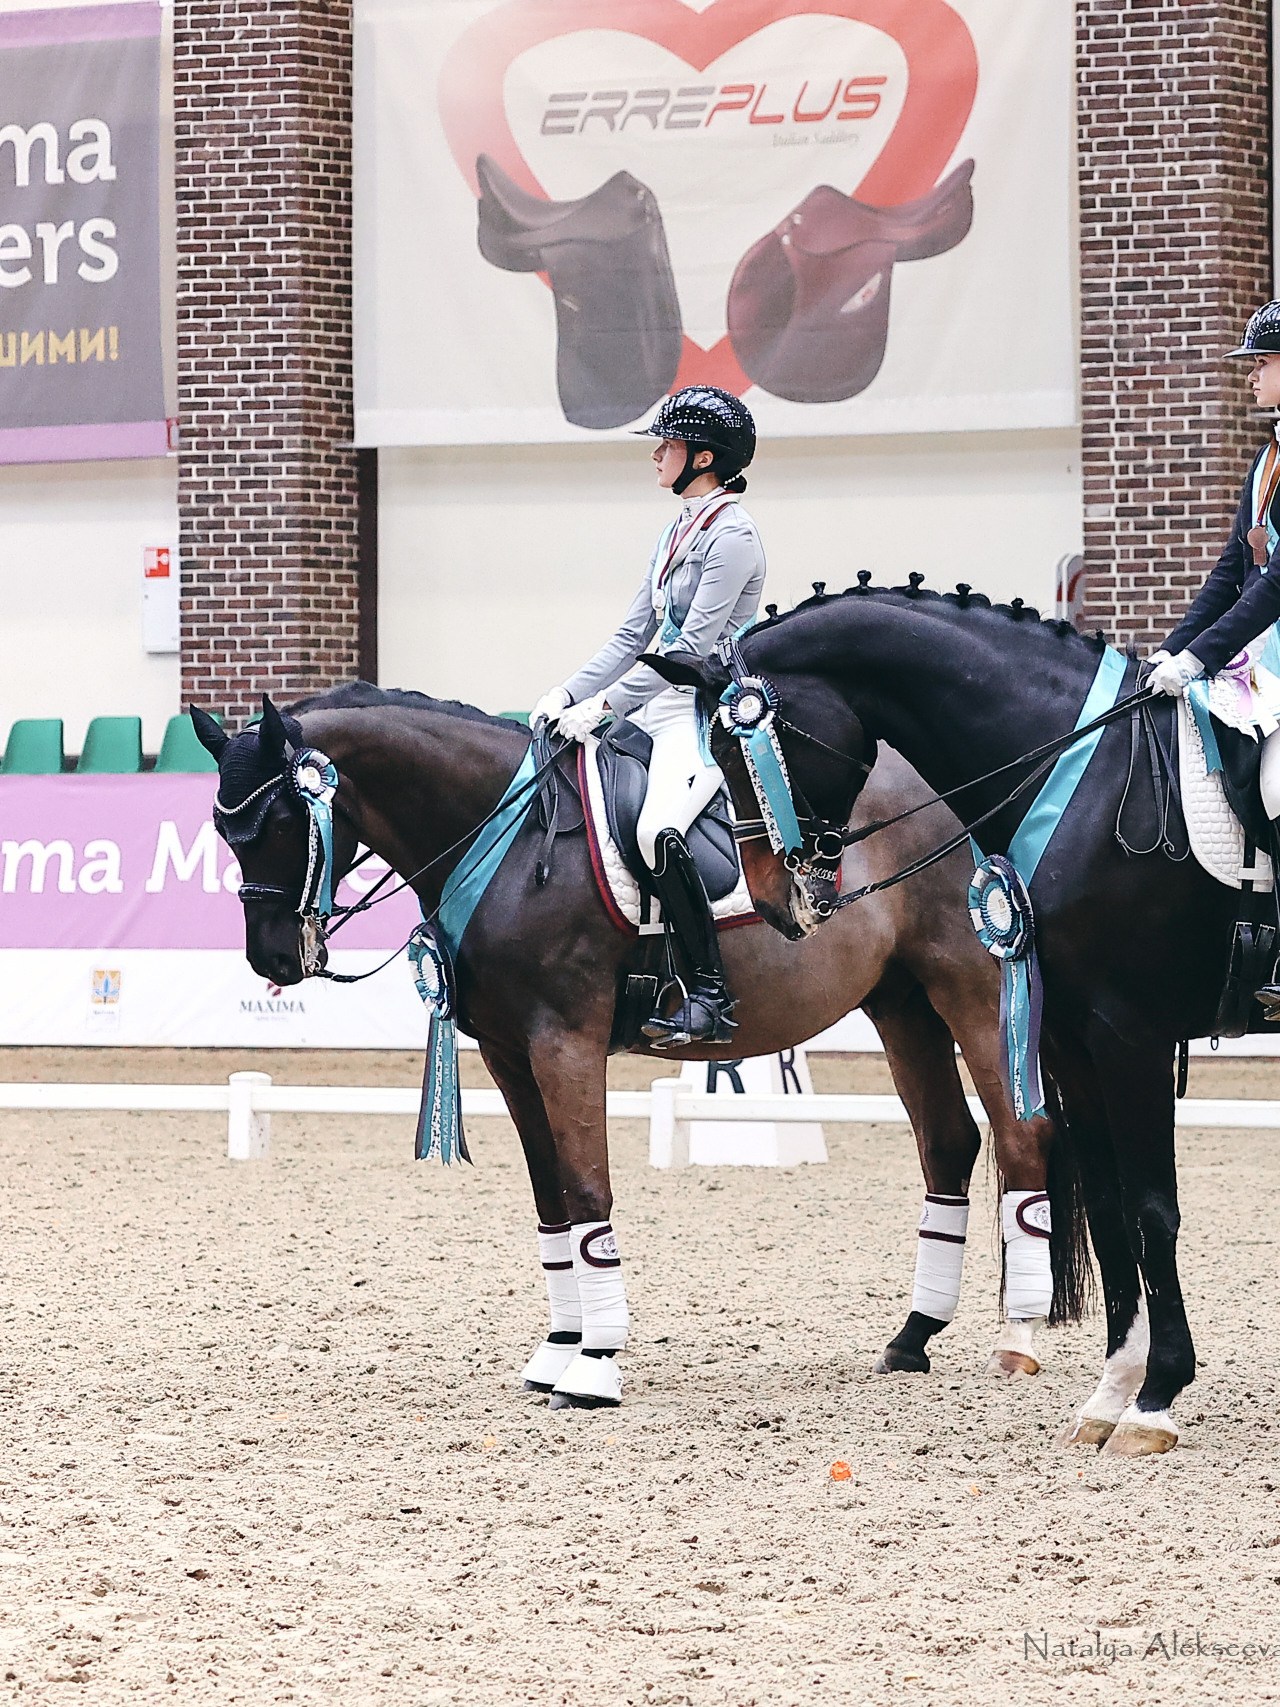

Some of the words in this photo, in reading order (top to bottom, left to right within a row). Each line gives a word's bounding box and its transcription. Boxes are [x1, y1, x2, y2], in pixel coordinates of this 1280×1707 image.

[540, 76, 888, 135] ERREPLUS
[0, 118, 117, 187] ma
[0, 217, 119, 288] ers
[0, 837, 124, 894] ma
[240, 1000, 305, 1014] MAXIMA
